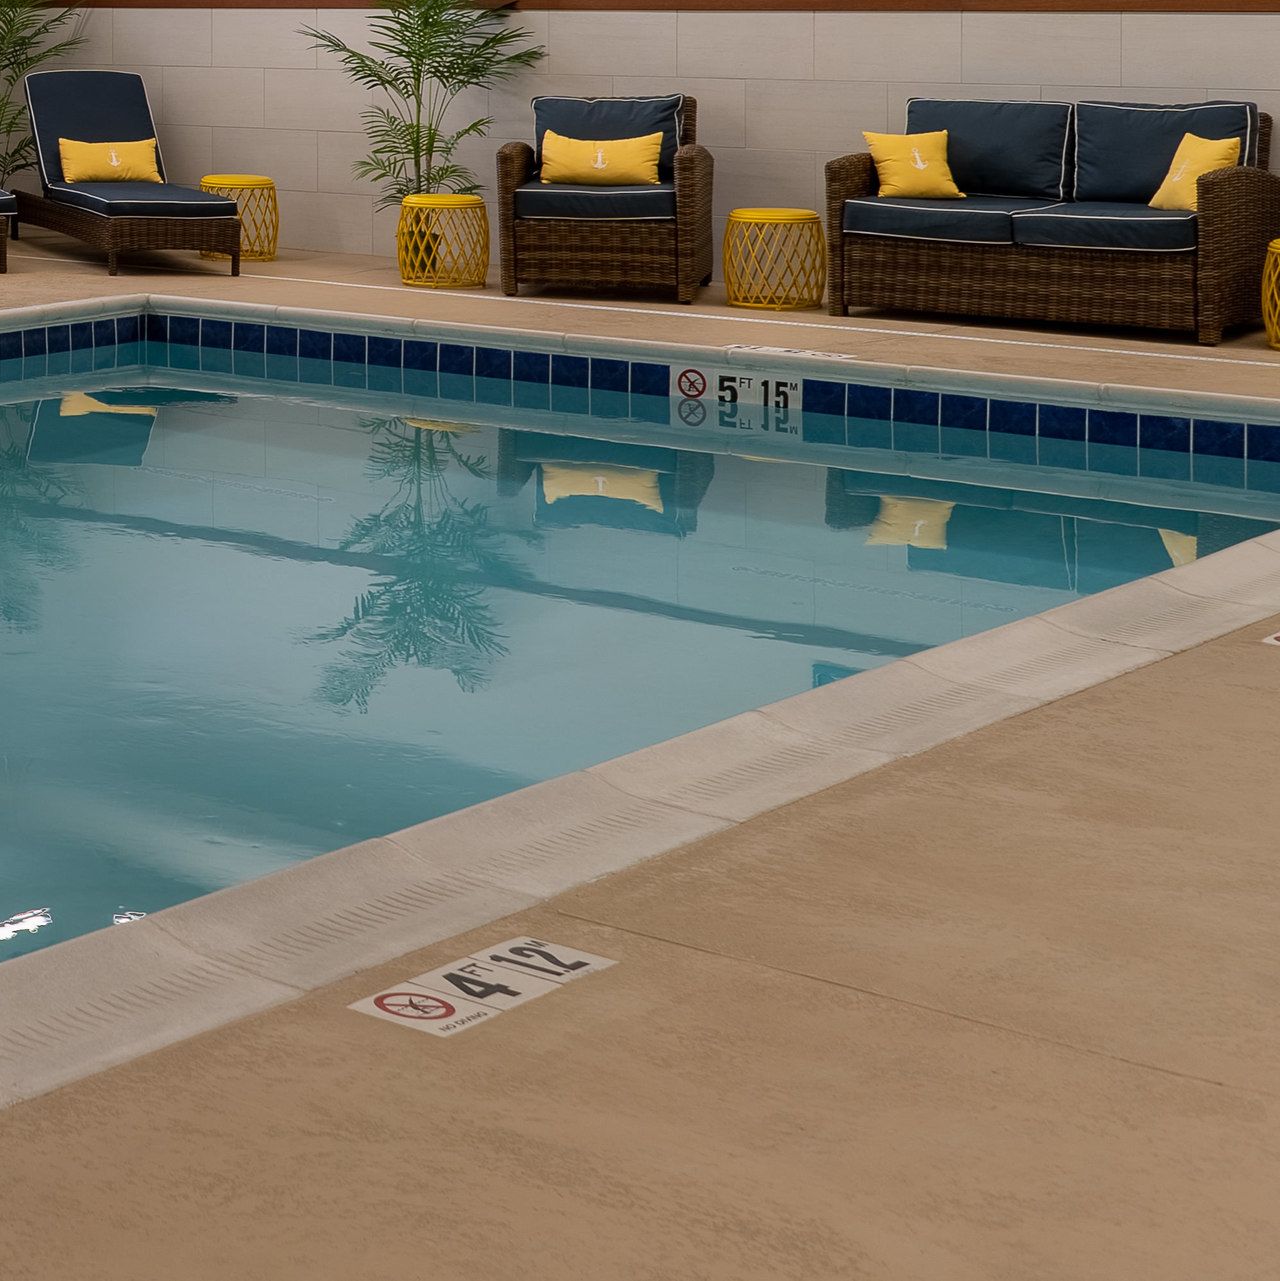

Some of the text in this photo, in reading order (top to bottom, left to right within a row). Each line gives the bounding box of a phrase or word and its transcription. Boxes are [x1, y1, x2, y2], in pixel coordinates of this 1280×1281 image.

[718, 375, 739, 403] 5
[739, 377, 753, 389] FT
[790, 383, 798, 392] M
[457, 962, 494, 977] FT
[441, 972, 522, 999] 4
[438, 1010, 488, 1032] NO DIVING
